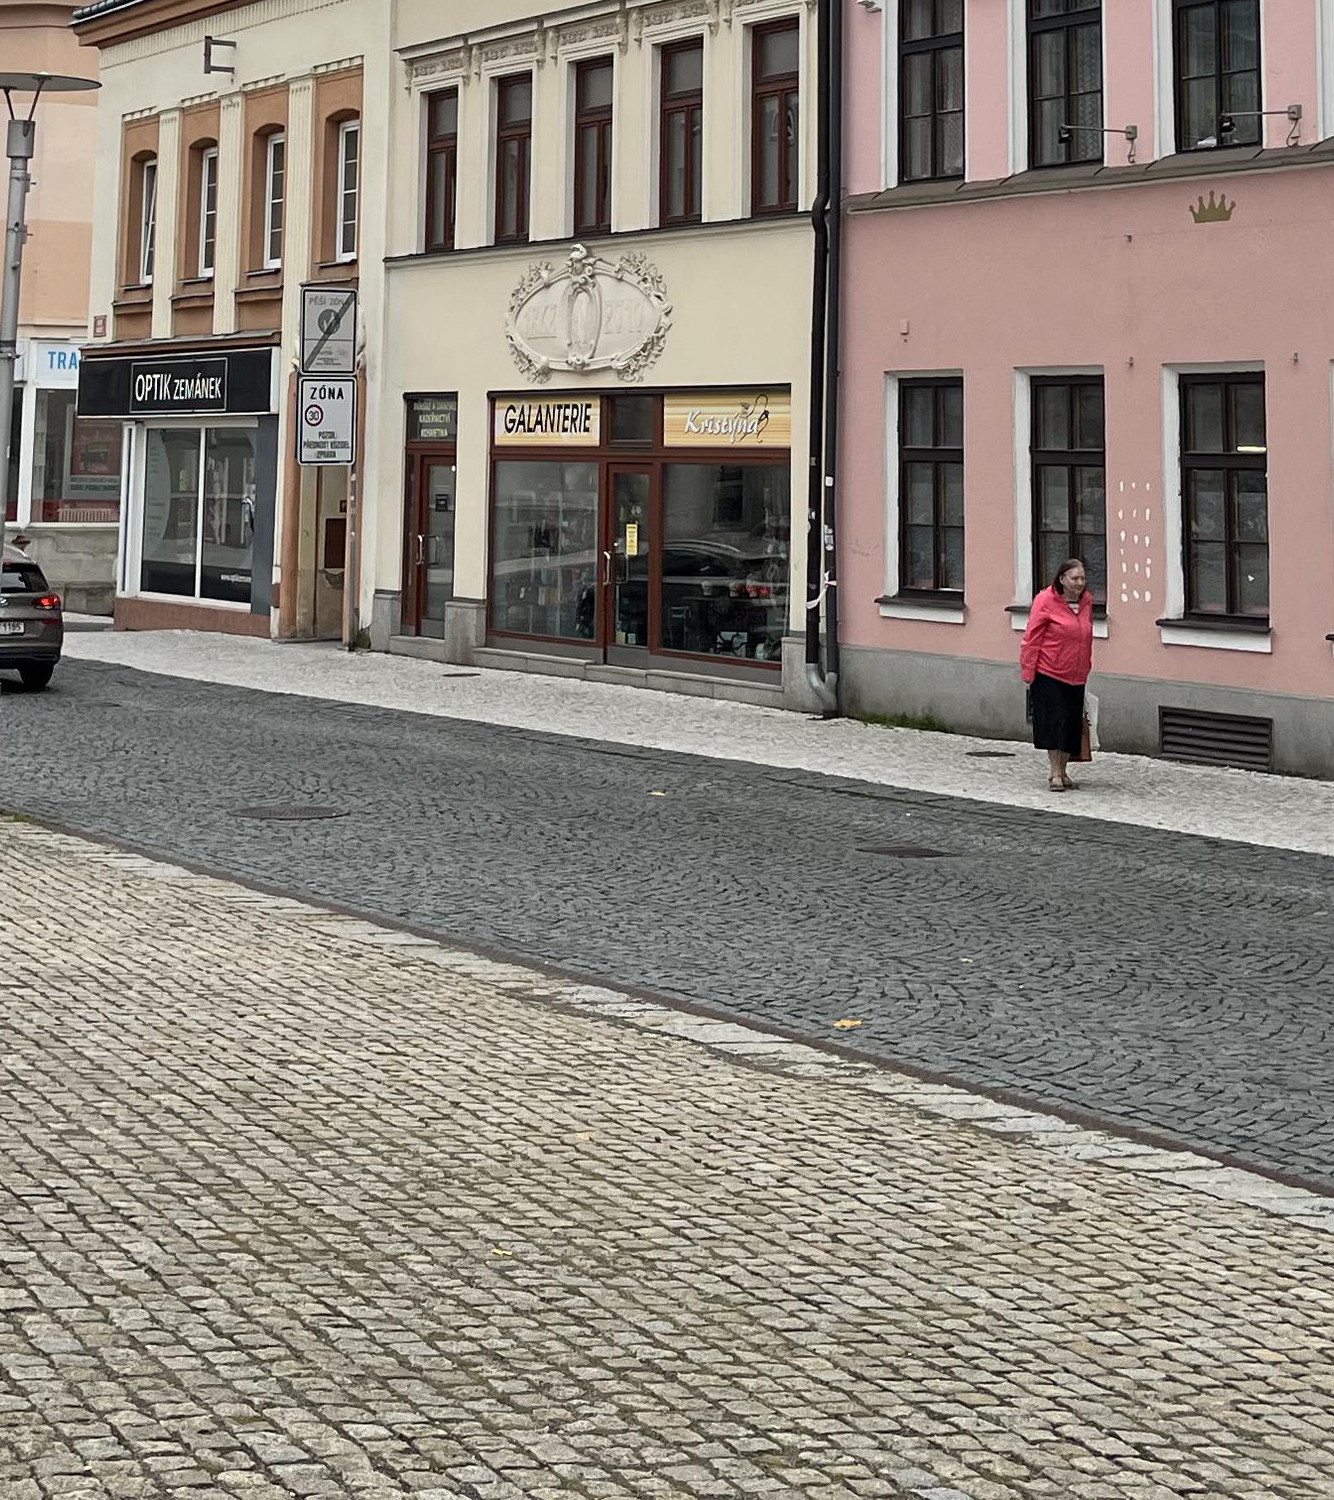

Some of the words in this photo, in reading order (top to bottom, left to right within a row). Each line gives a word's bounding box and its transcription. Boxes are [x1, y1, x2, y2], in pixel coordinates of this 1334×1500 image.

[135, 374, 172, 402] OPTIK
[173, 372, 222, 400] ZEMÁNEK
[309, 384, 344, 400] ZÓNA
[308, 410, 320, 421] 30
[504, 403, 592, 434] GALANTERIE
[684, 408, 759, 444] Kristýna
